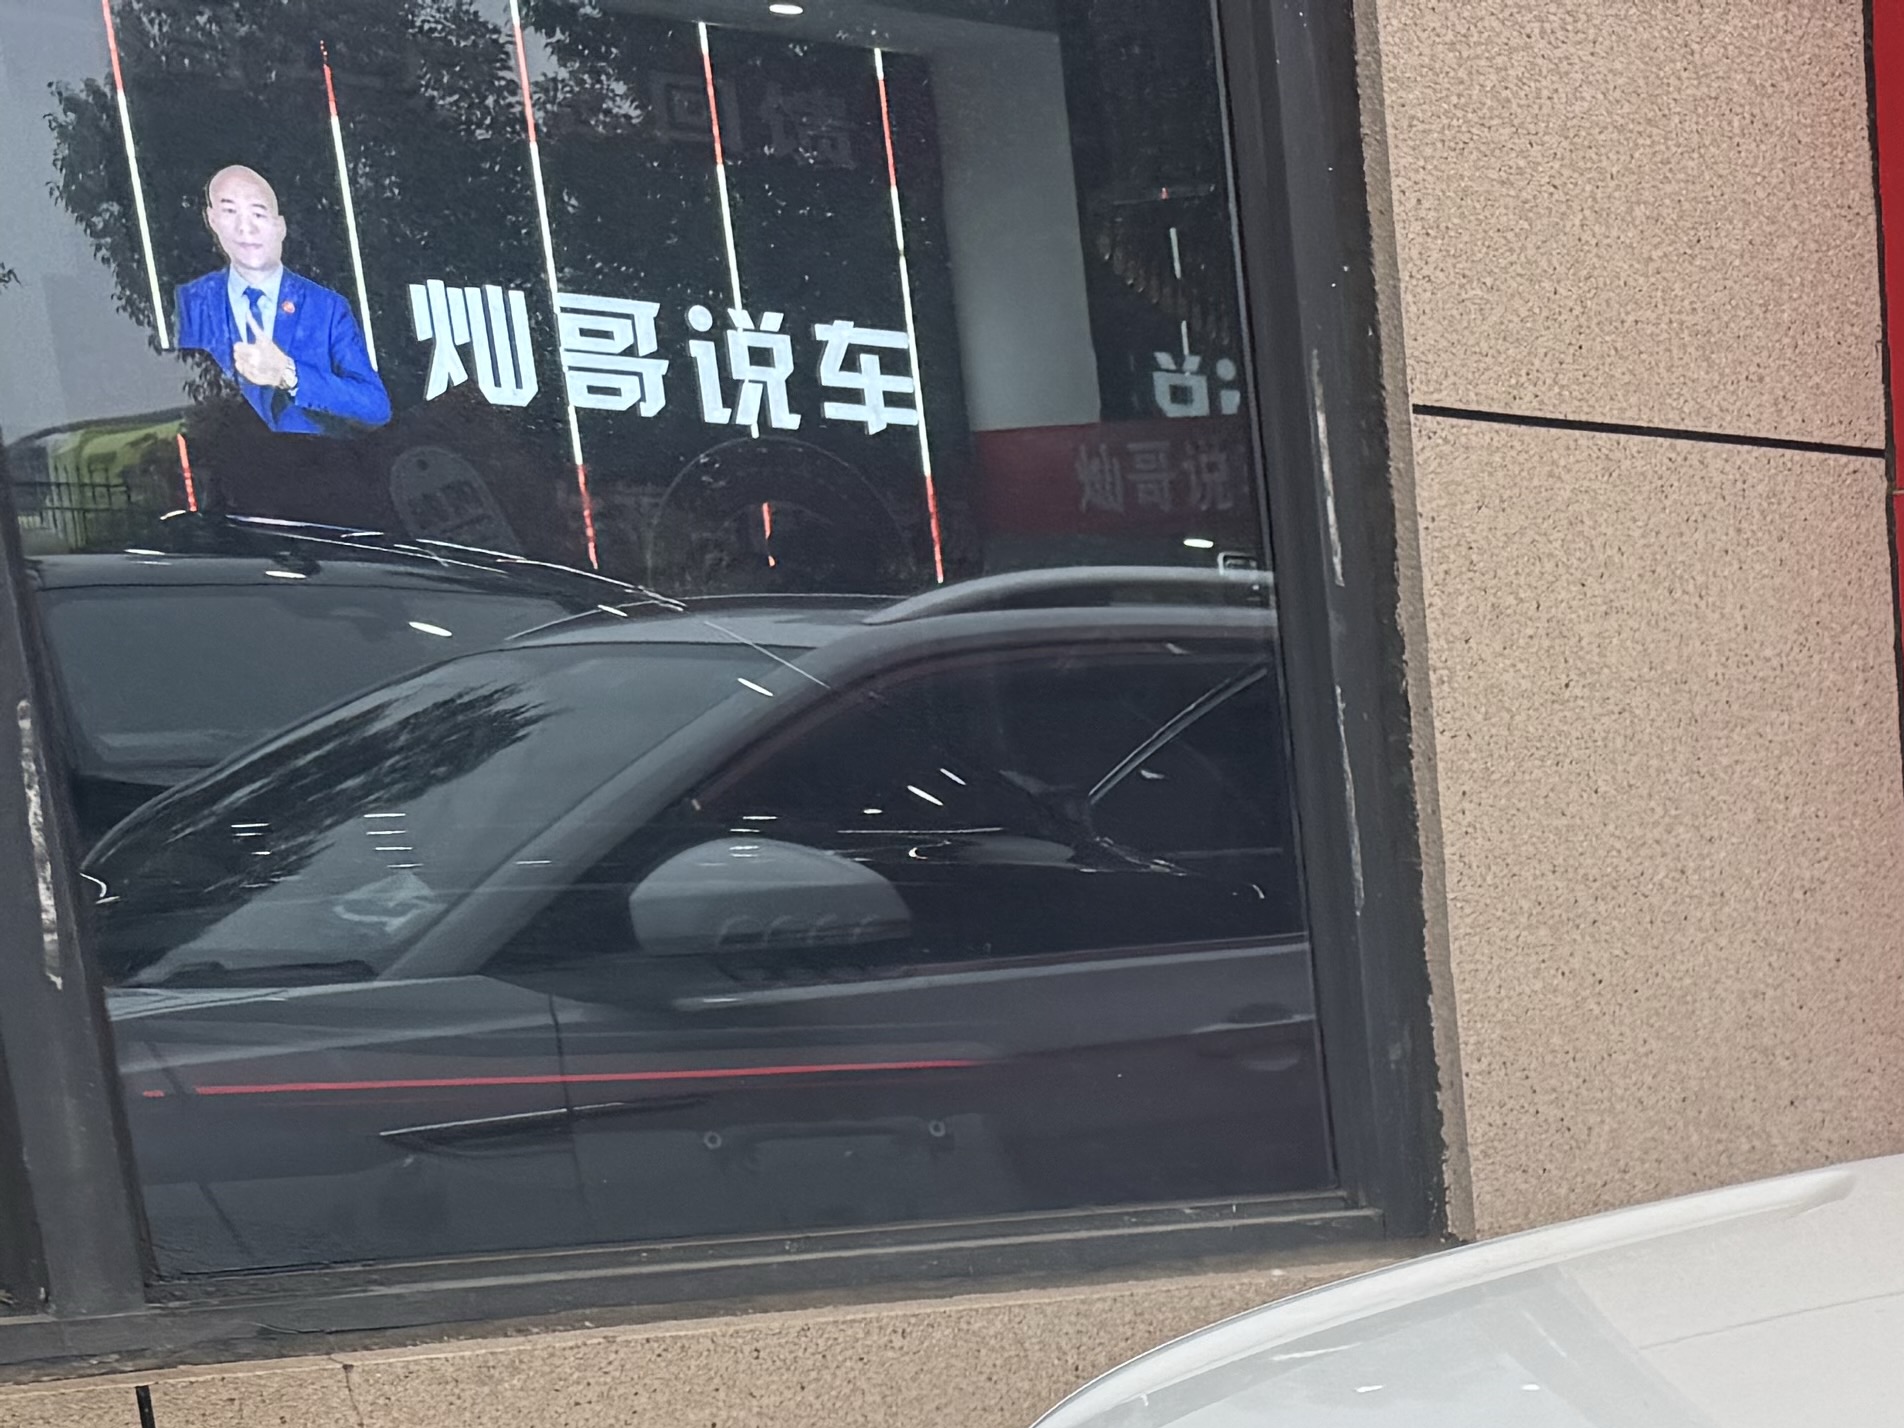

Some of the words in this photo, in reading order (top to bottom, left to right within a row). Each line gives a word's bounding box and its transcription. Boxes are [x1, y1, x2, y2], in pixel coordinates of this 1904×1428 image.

[409, 279, 920, 435] 灿哥说车
[1075, 440, 1248, 514] 灿哥说
